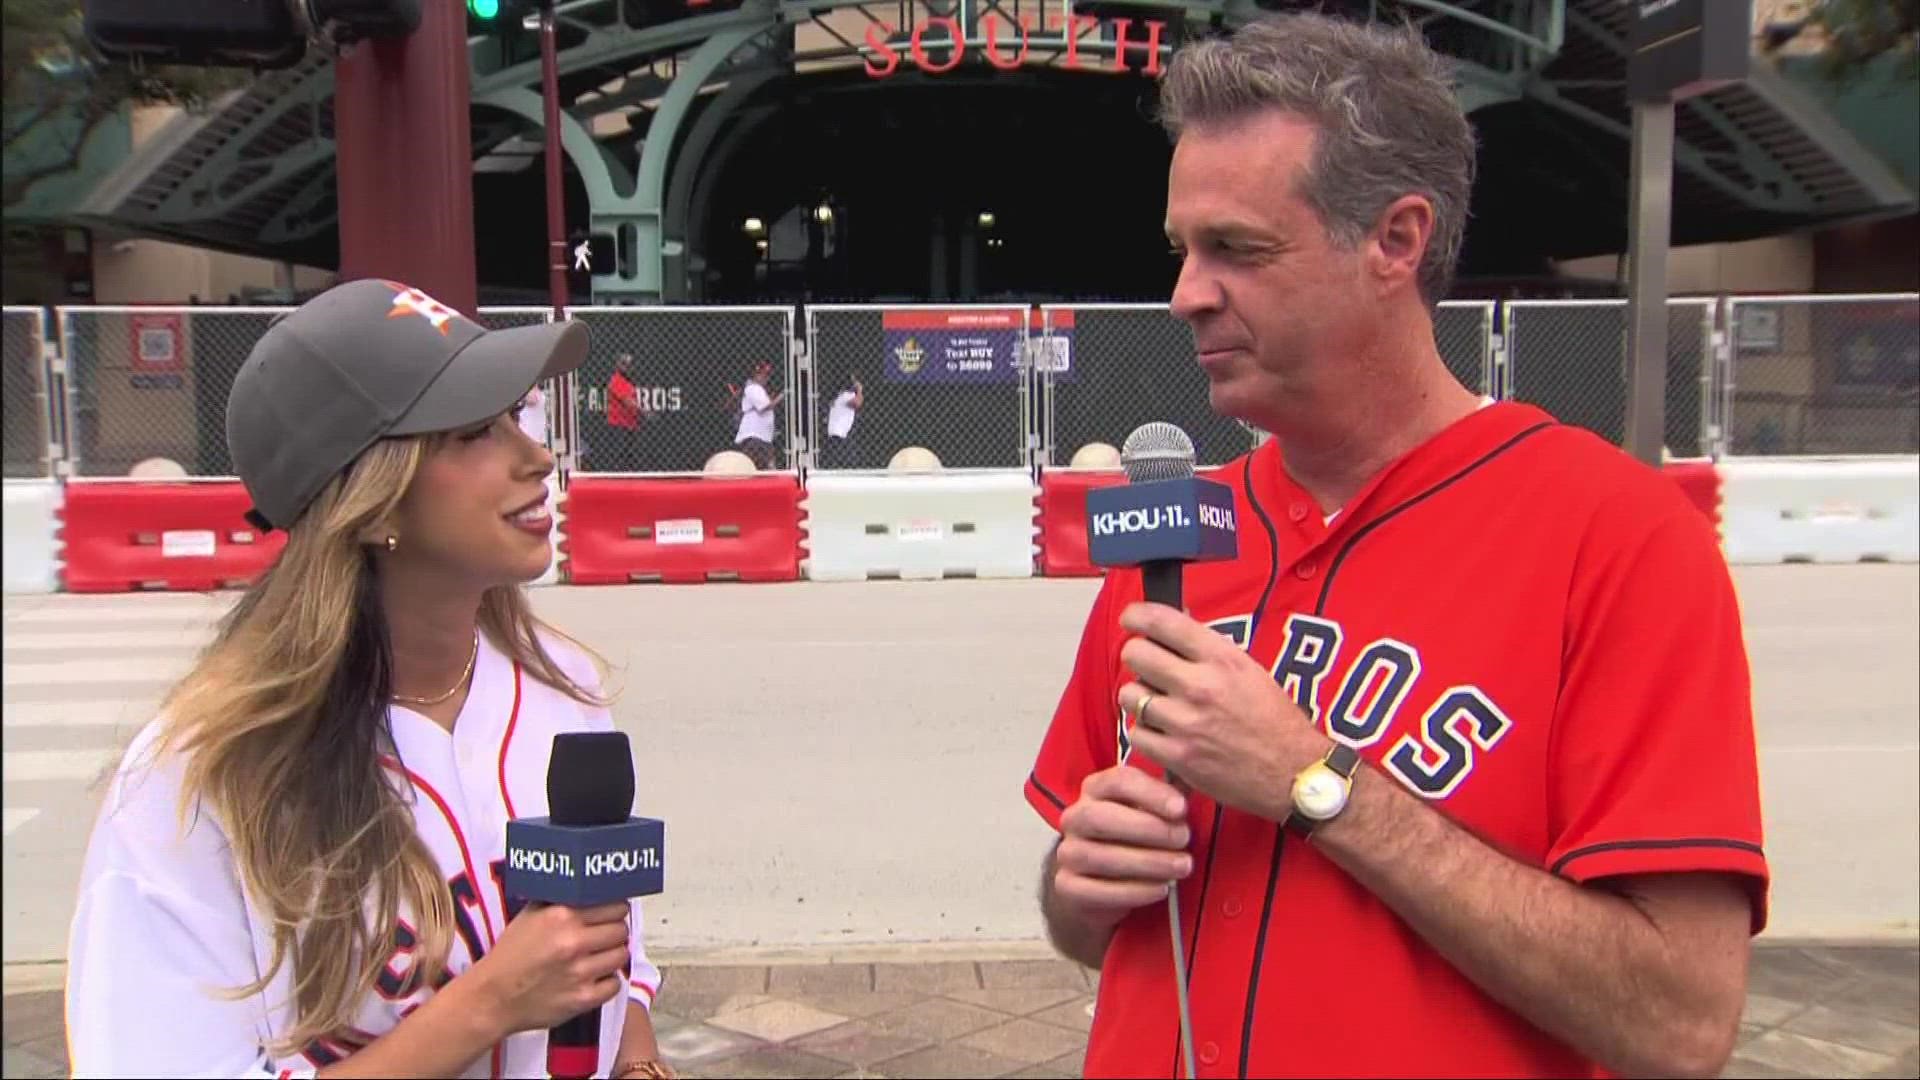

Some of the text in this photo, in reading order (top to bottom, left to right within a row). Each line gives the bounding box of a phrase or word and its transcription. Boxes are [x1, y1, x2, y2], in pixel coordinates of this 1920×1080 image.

[864, 14, 1167, 78] SOUTH
[945, 348, 968, 358] Text
[1205, 612, 1513, 800] ROS
